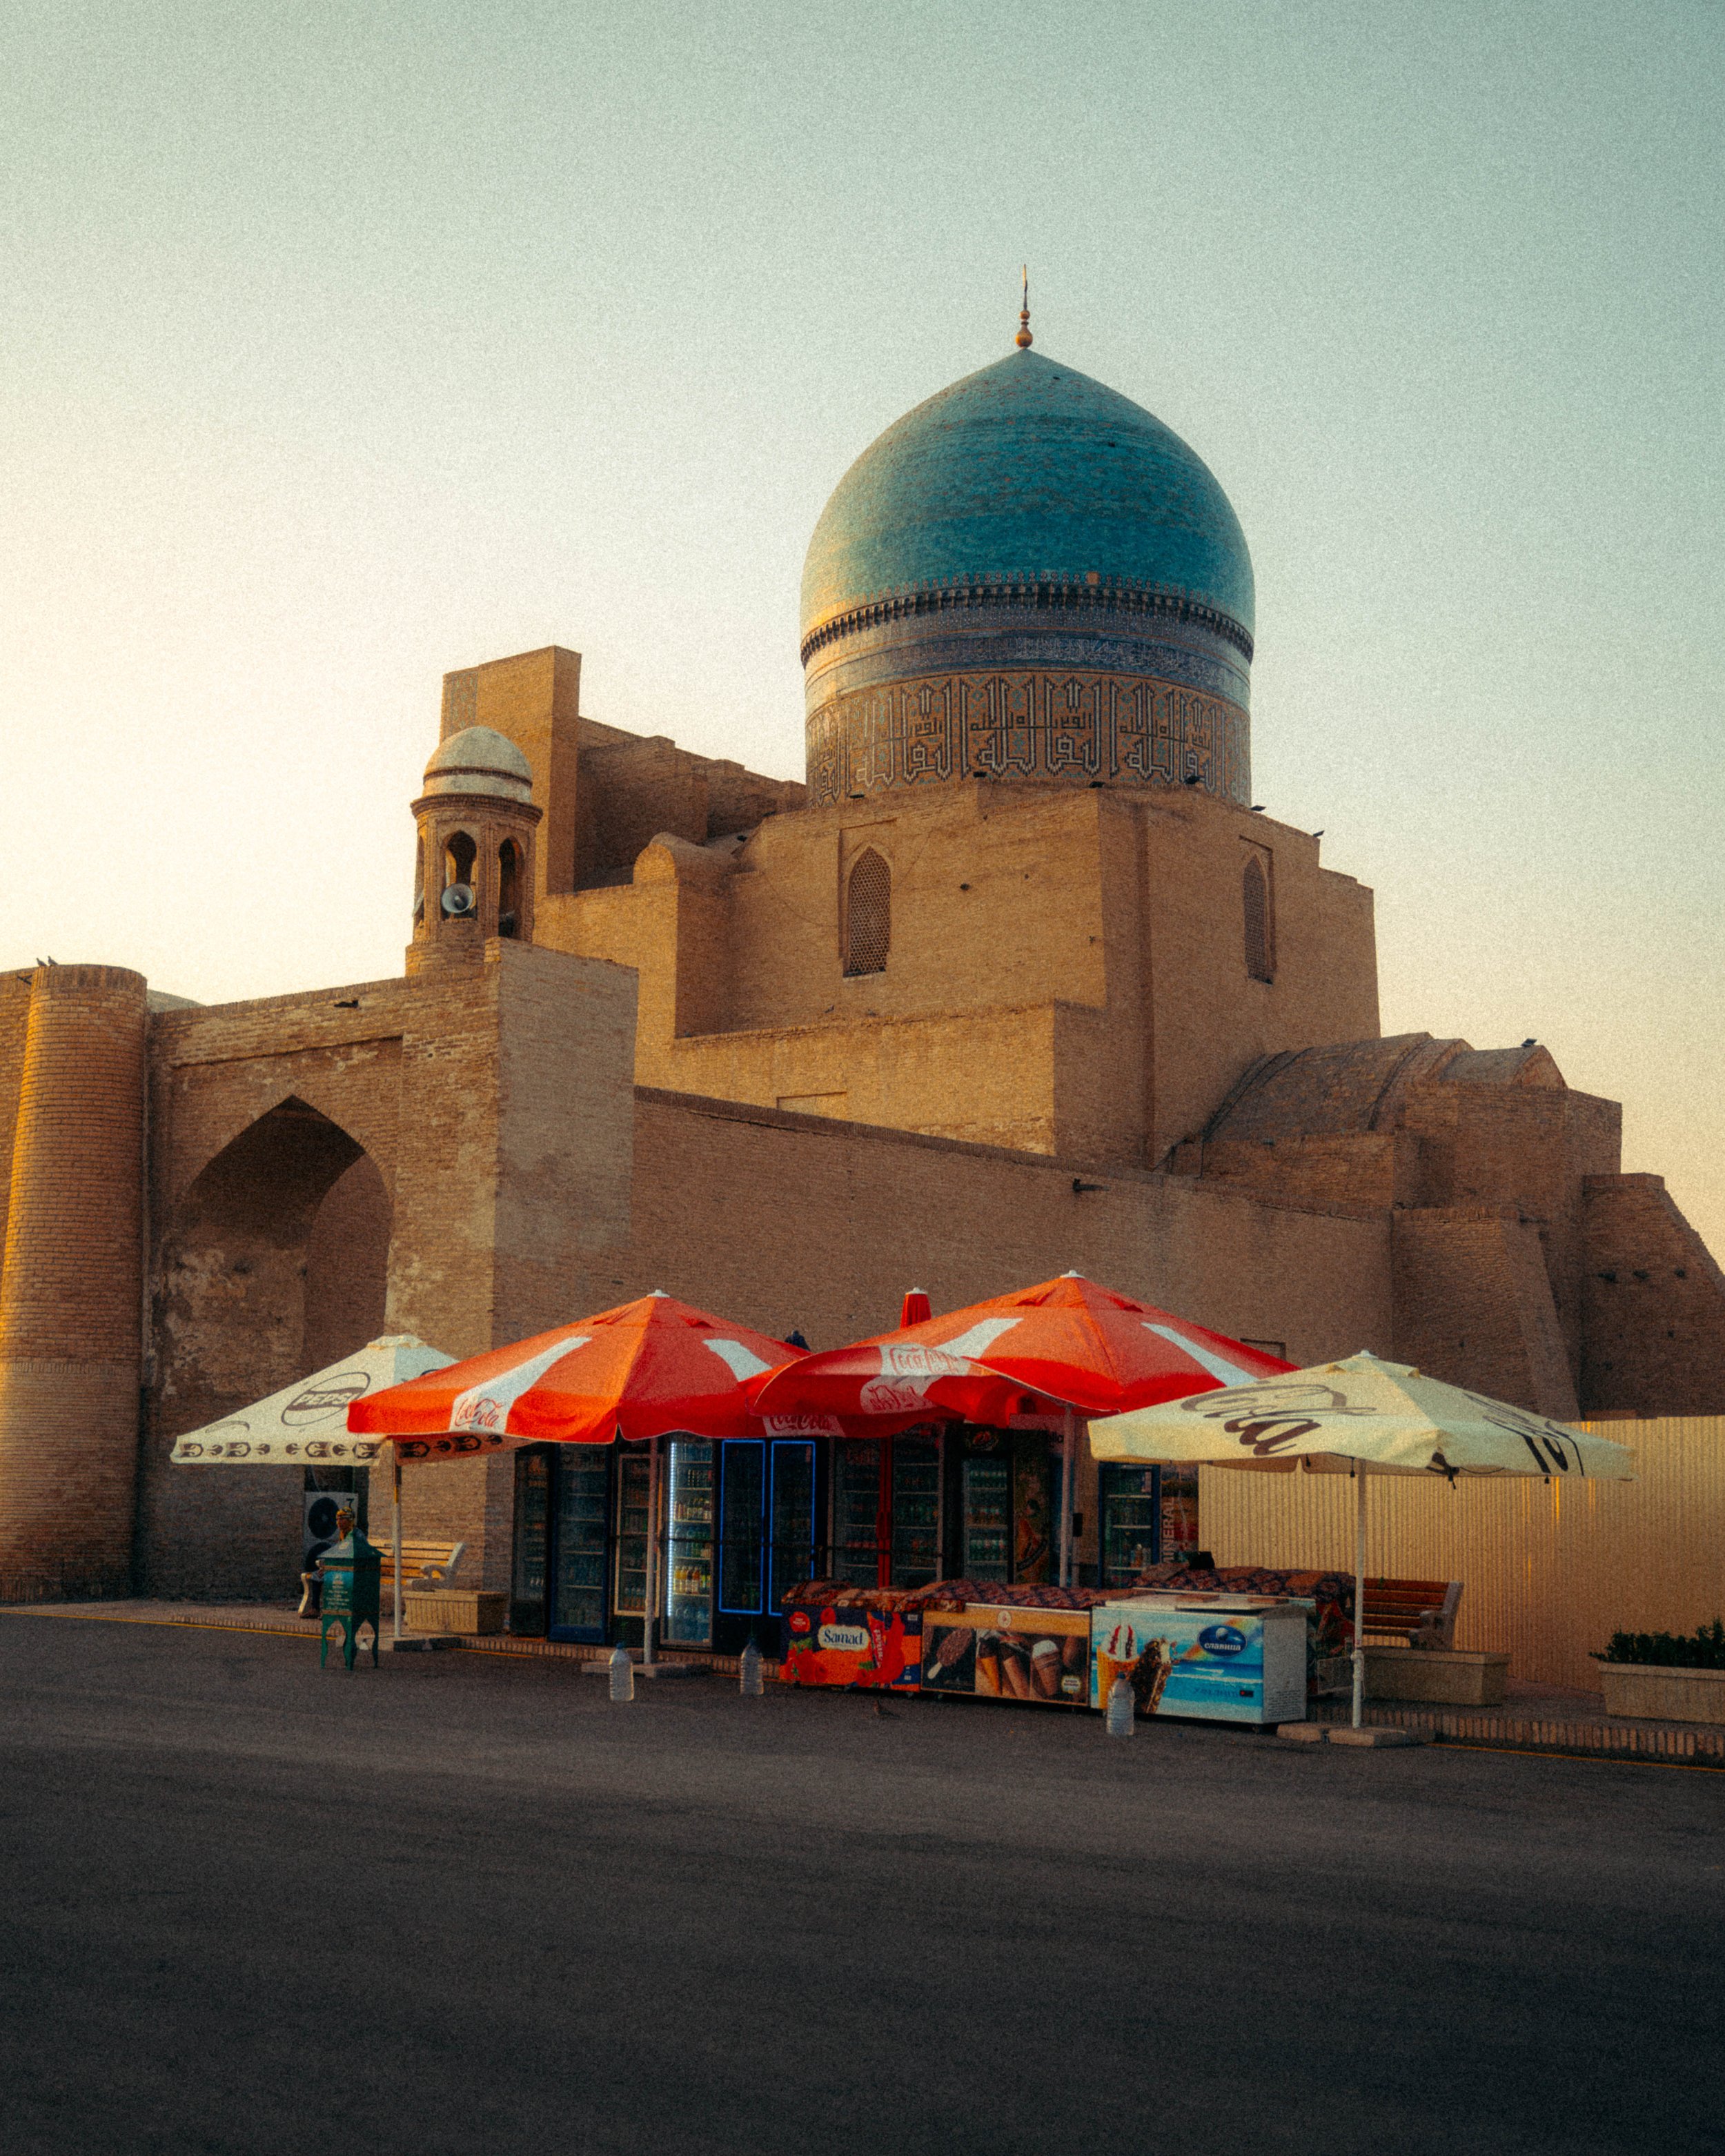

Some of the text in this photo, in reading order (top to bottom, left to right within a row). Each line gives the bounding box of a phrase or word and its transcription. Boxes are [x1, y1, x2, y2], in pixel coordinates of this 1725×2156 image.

[293, 1392, 359, 1406] PEPSI
[823, 1628, 863, 1645] Samad
[1204, 1642, 1241, 1652] славица
